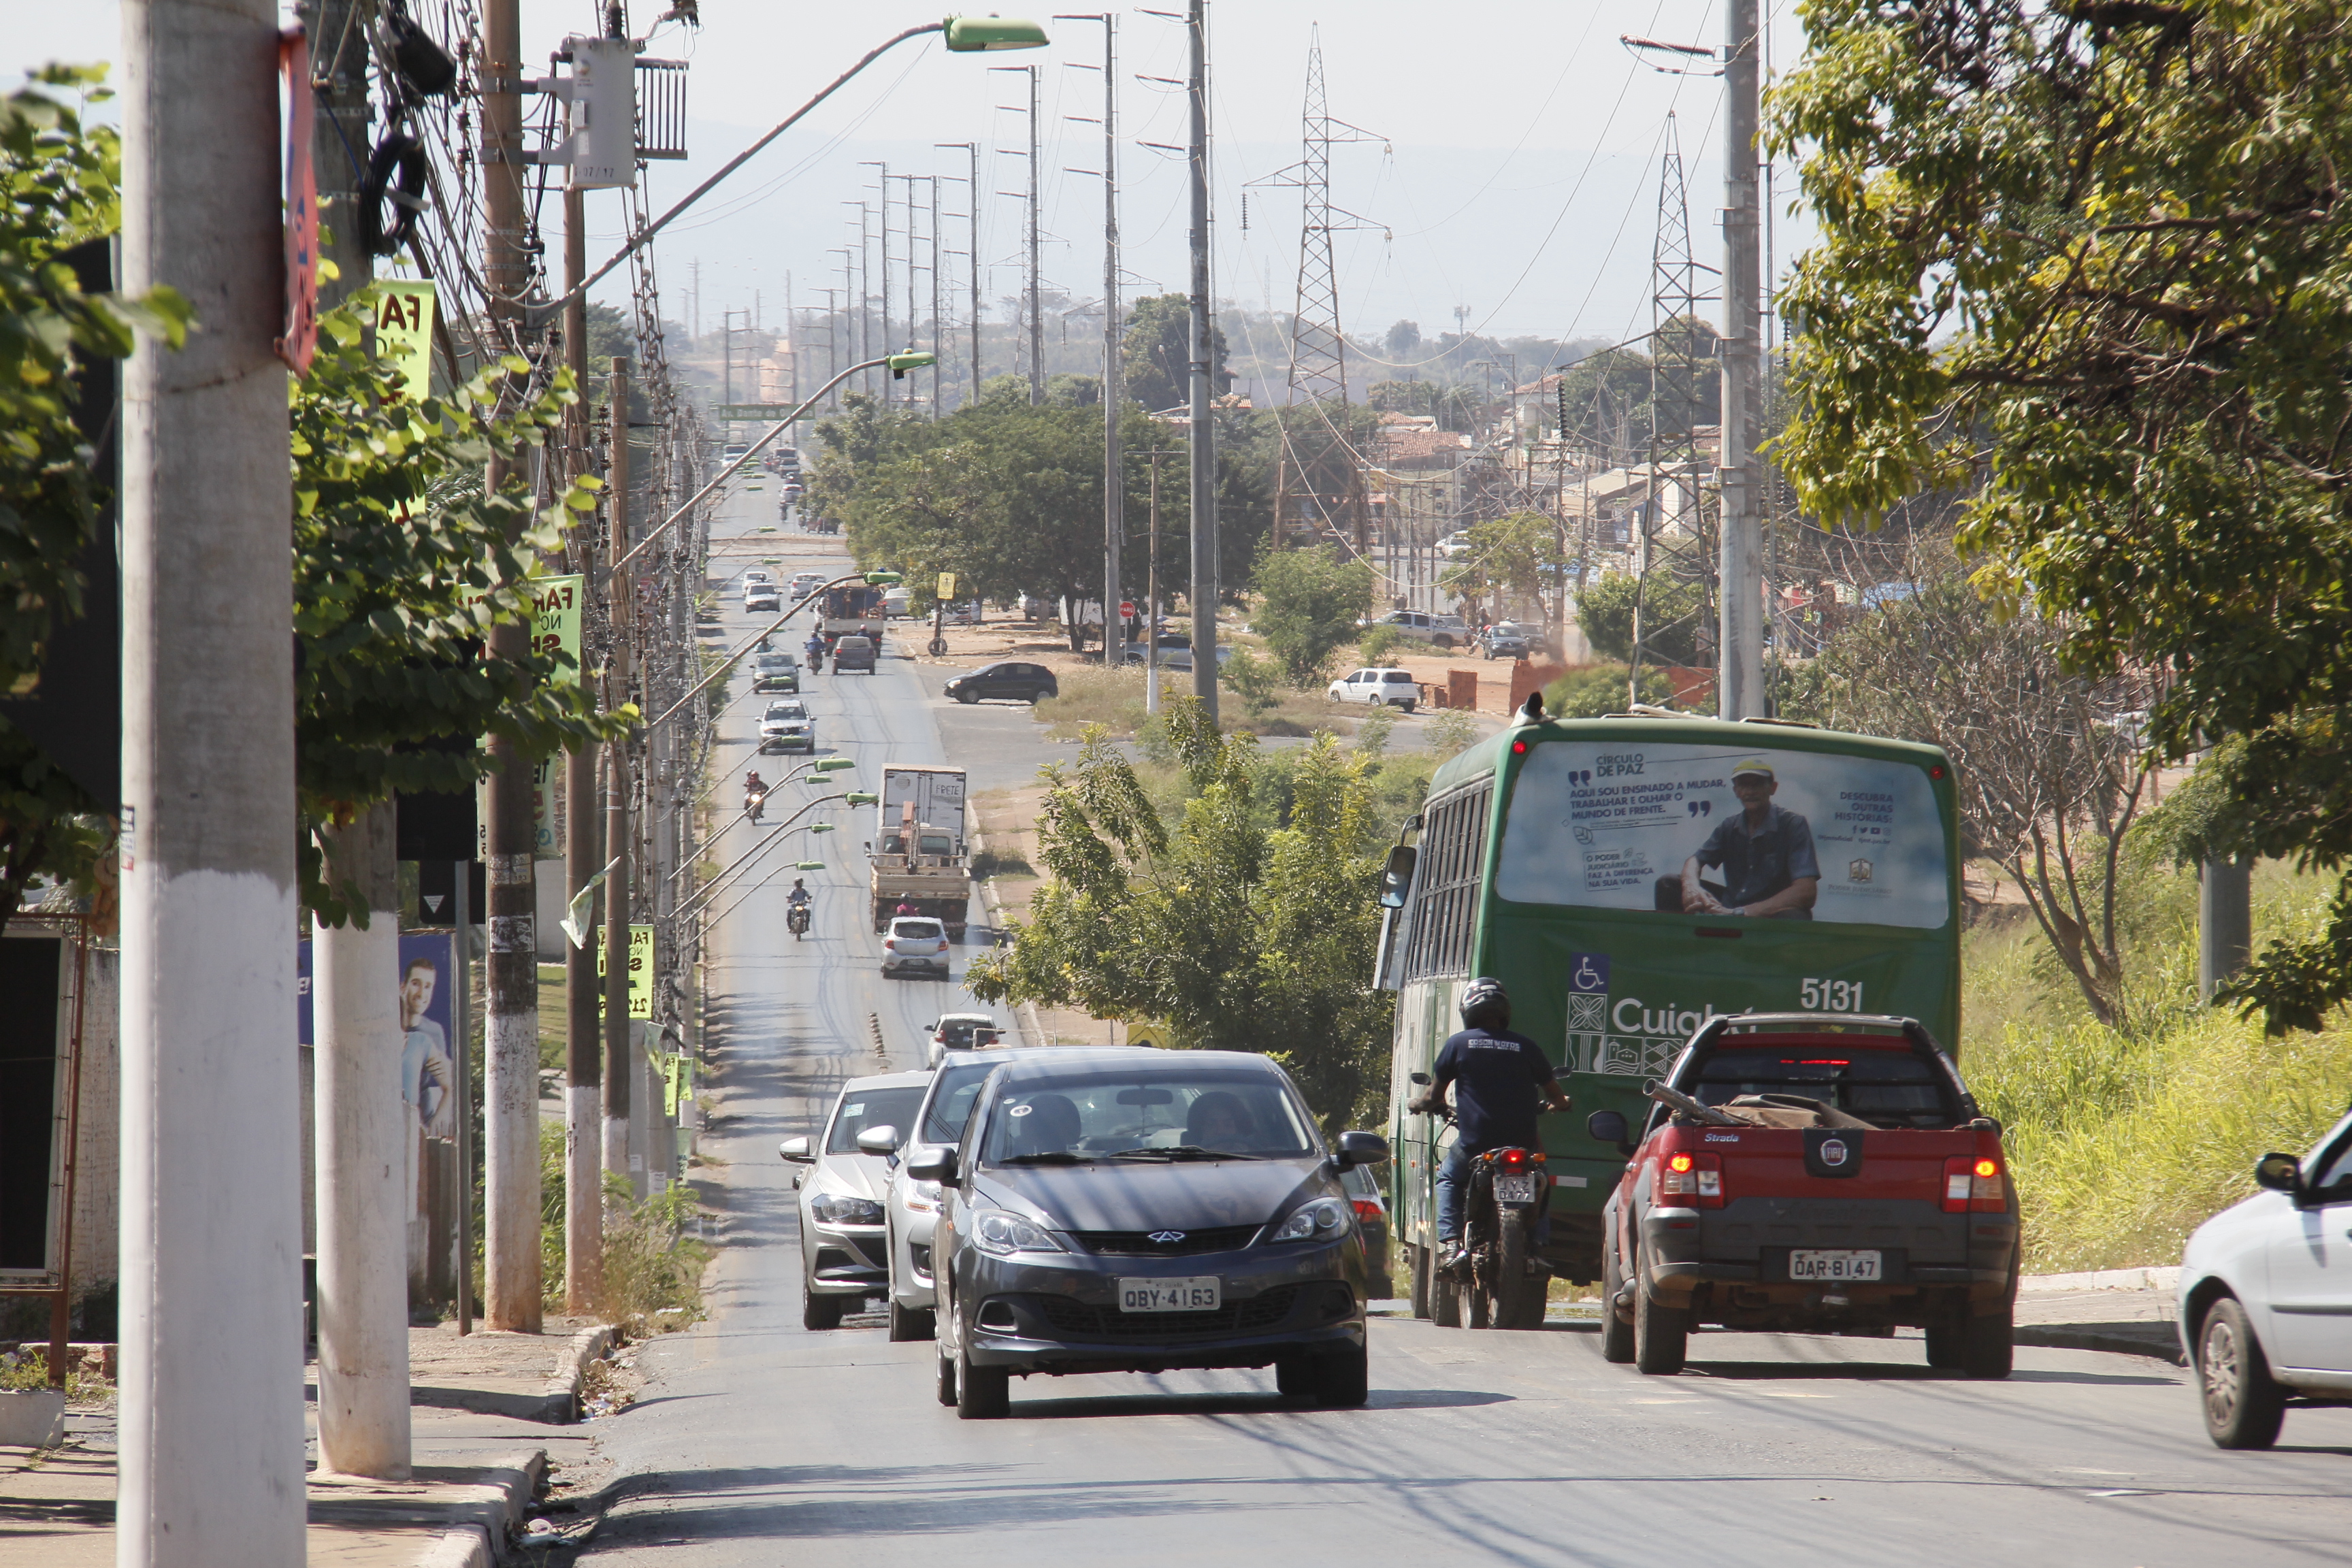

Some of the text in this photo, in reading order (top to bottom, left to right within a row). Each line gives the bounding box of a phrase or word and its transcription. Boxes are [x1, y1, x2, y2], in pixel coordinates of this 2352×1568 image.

[1596, 753, 1644, 766] CÍRCULO
[1597, 763, 1644, 777] DE PAZ
[936, 784, 960, 795] FRETE
[1570, 779, 1727, 798] AQUI SOU ENSINADO A MUDAR,
[1571, 798, 1628, 809] TRABALHAR
[1638, 794, 1671, 804] OLHAR
[1674, 792, 1683, 801] O
[1840, 791, 1893, 802] DESCUBRA
[1571, 804, 1666, 820] MUNDO DE FRENTE.
[1851, 802, 1893, 813] OUTRAS
[1835, 811, 1892, 823] HISTÓRIAS:
[1595, 853, 1620, 862] PODER
[1614, 868, 1654, 877] DIFERENÇA
[1620, 877, 1641, 885] VIDA.
[1800, 978, 1863, 1013] 5131
[1705, 1133, 1740, 1142] Strada
[1827, 1147, 1842, 1158] FIAT
[1499, 1181, 1529, 1190] JYZ
[1499, 1191, 1530, 1200] 0477
